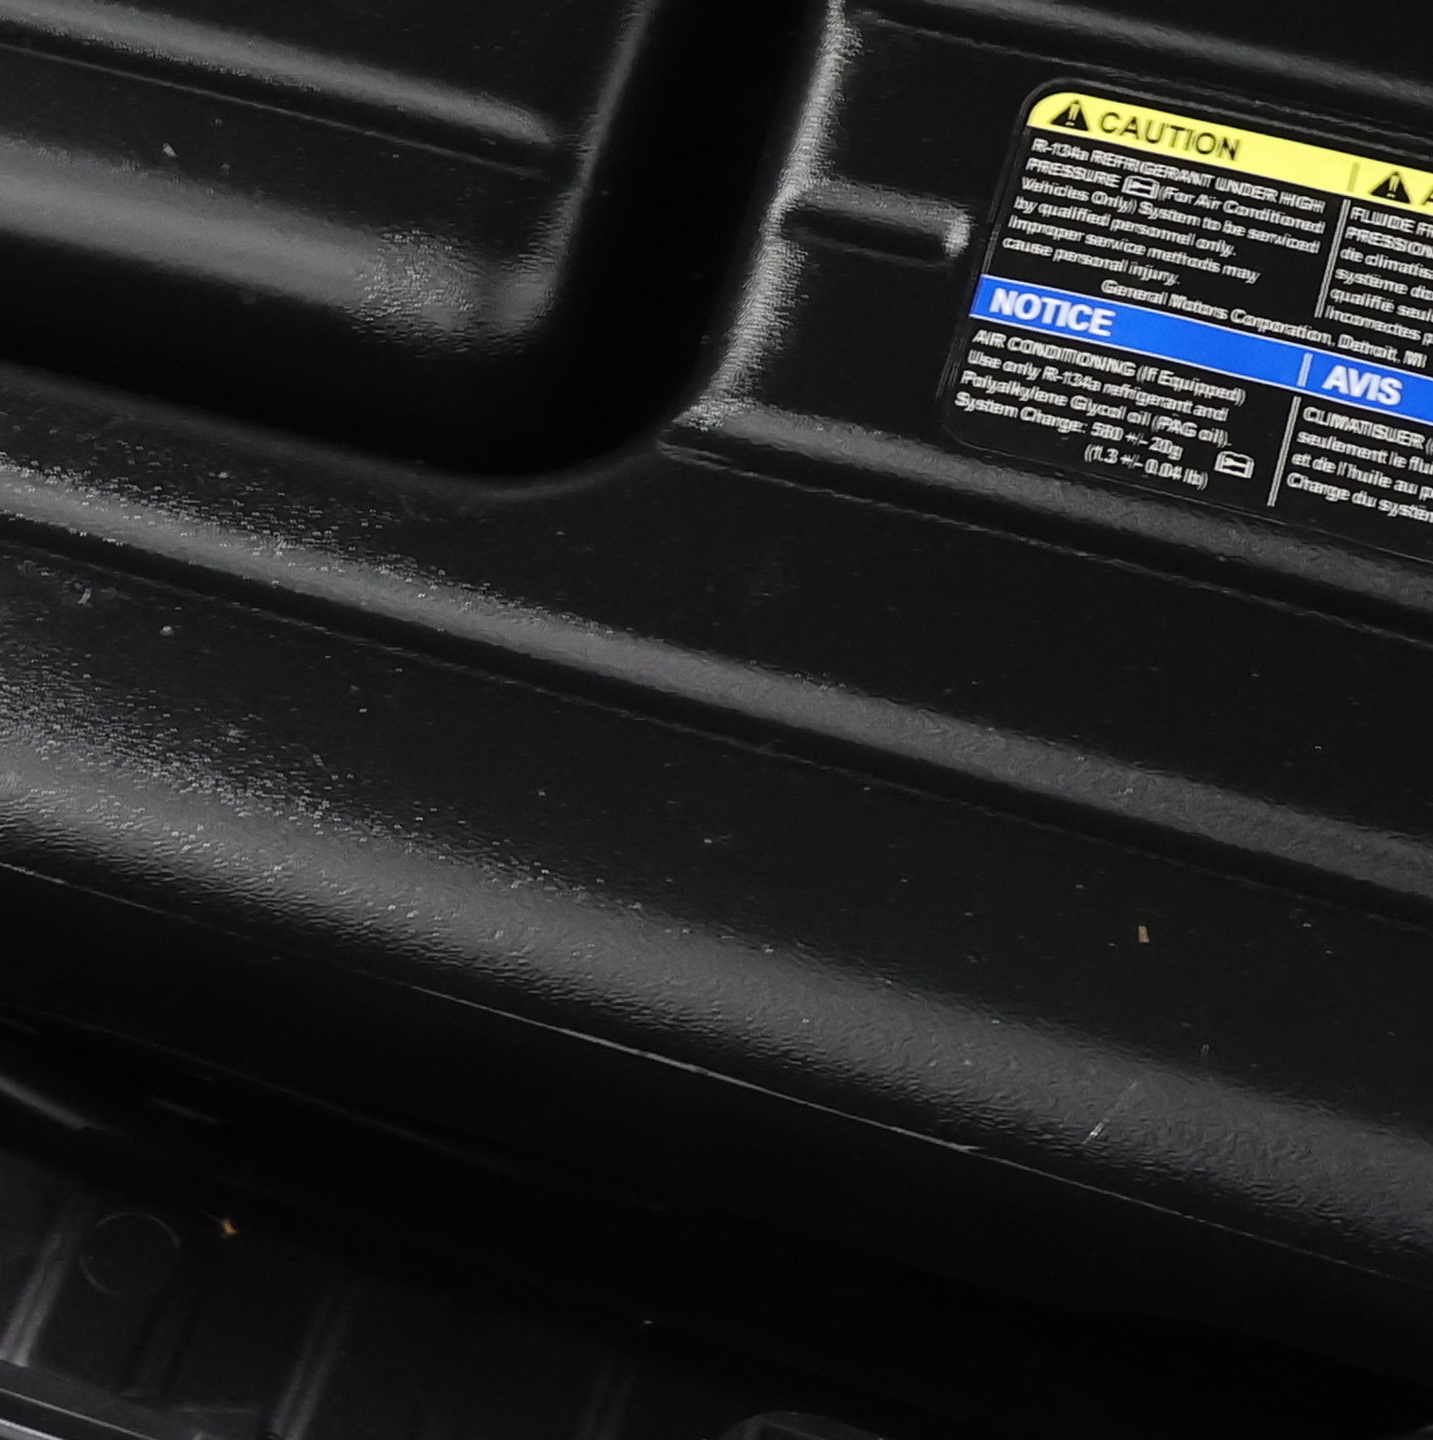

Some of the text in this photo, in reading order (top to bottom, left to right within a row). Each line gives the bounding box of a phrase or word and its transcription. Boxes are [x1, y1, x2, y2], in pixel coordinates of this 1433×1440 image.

[1100, 111, 1242, 161] CAUTION
[1025, 157, 1121, 187] PRESSURE
[1193, 194, 1222, 209] Air
[1222, 199, 1325, 234] Conditioned
[1031, 138, 1325, 213] R-134a REFRIGERANT UNDER HIGH
[1013, 196, 1235, 257] by qualified personnel only.
[1022, 176, 1089, 201] Vehicles
[1137, 201, 1201, 226] System
[1202, 217, 1221, 230] to
[1222, 220, 1246, 236] be
[1246, 228, 1320, 253] serviced
[1350, 206, 1415, 233] FLUIDE
[1002, 237, 1179, 286] cause personal injury.
[1007, 214, 1260, 284] Improper service methods may
[1339, 247, 1363, 262] de
[1334, 268, 1408, 294] système
[990, 288, 1115, 336] NOTICE
[1101, 279, 1168, 305] General
[1167, 293, 1228, 319] Motors
[1403, 350, 1427, 368] MI
[972, 329, 1006, 348] AIR
[1006, 336, 1136, 376] CONDITIONING
[960, 370, 1068, 406] Polyalkylene
[1070, 395, 1127, 419] Glycol
[1126, 411, 1151, 426] oil
[967, 349, 1229, 421] Use only R-134a refrigerant and
[1322, 366, 1401, 404] AVIS
[954, 391, 1018, 418] System
[1148, 436, 1183, 460] 20g
[1296, 431, 1388, 464] seulement
[1388, 451, 1407, 468] le
[1291, 453, 1311, 467] et
[1312, 456, 1336, 473] de
[1393, 479, 1418, 494] au
[1351, 490, 1377, 507] du
